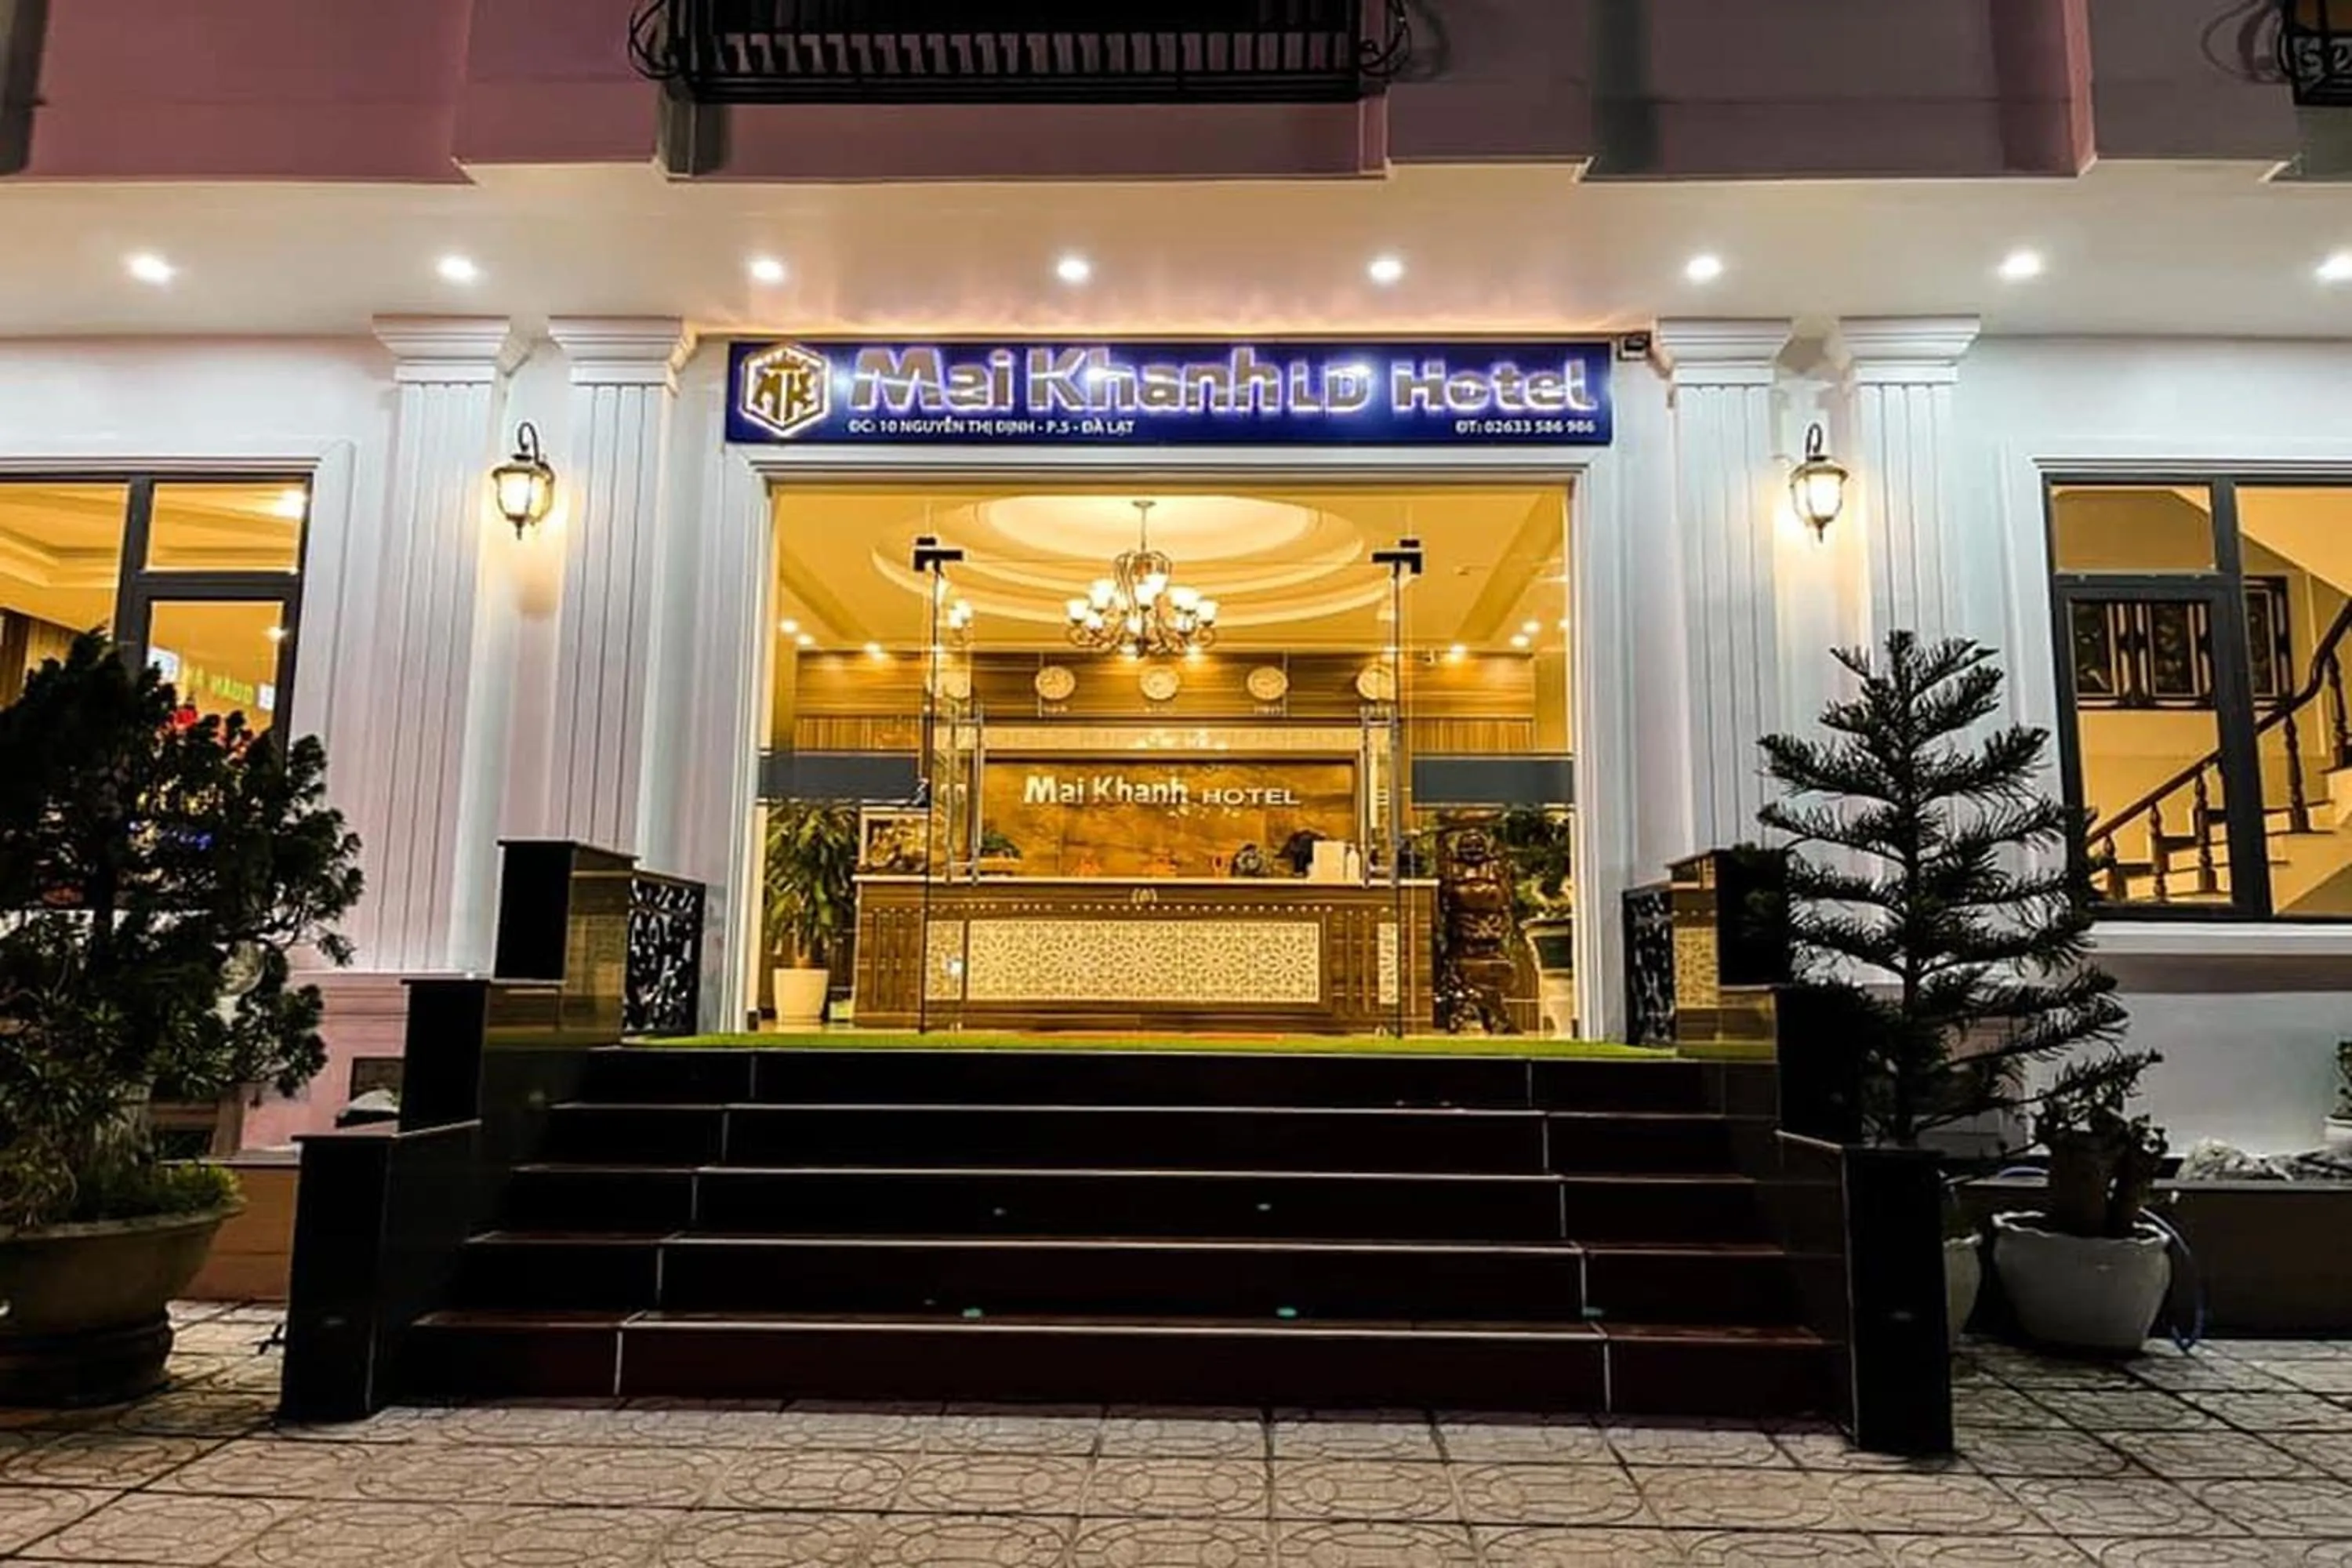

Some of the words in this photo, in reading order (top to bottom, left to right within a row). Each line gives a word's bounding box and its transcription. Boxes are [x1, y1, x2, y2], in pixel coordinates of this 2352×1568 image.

[849, 347, 1013, 411] Mai
[1027, 345, 1281, 412] Khanh
[1289, 358, 1370, 412] LD
[1391, 358, 1597, 412] Hotel
[880, 419, 898, 433] 10
[1024, 775, 1084, 804] Mai
[1094, 775, 1189, 804] Khanh
[1201, 788, 1301, 805] HOTEL
